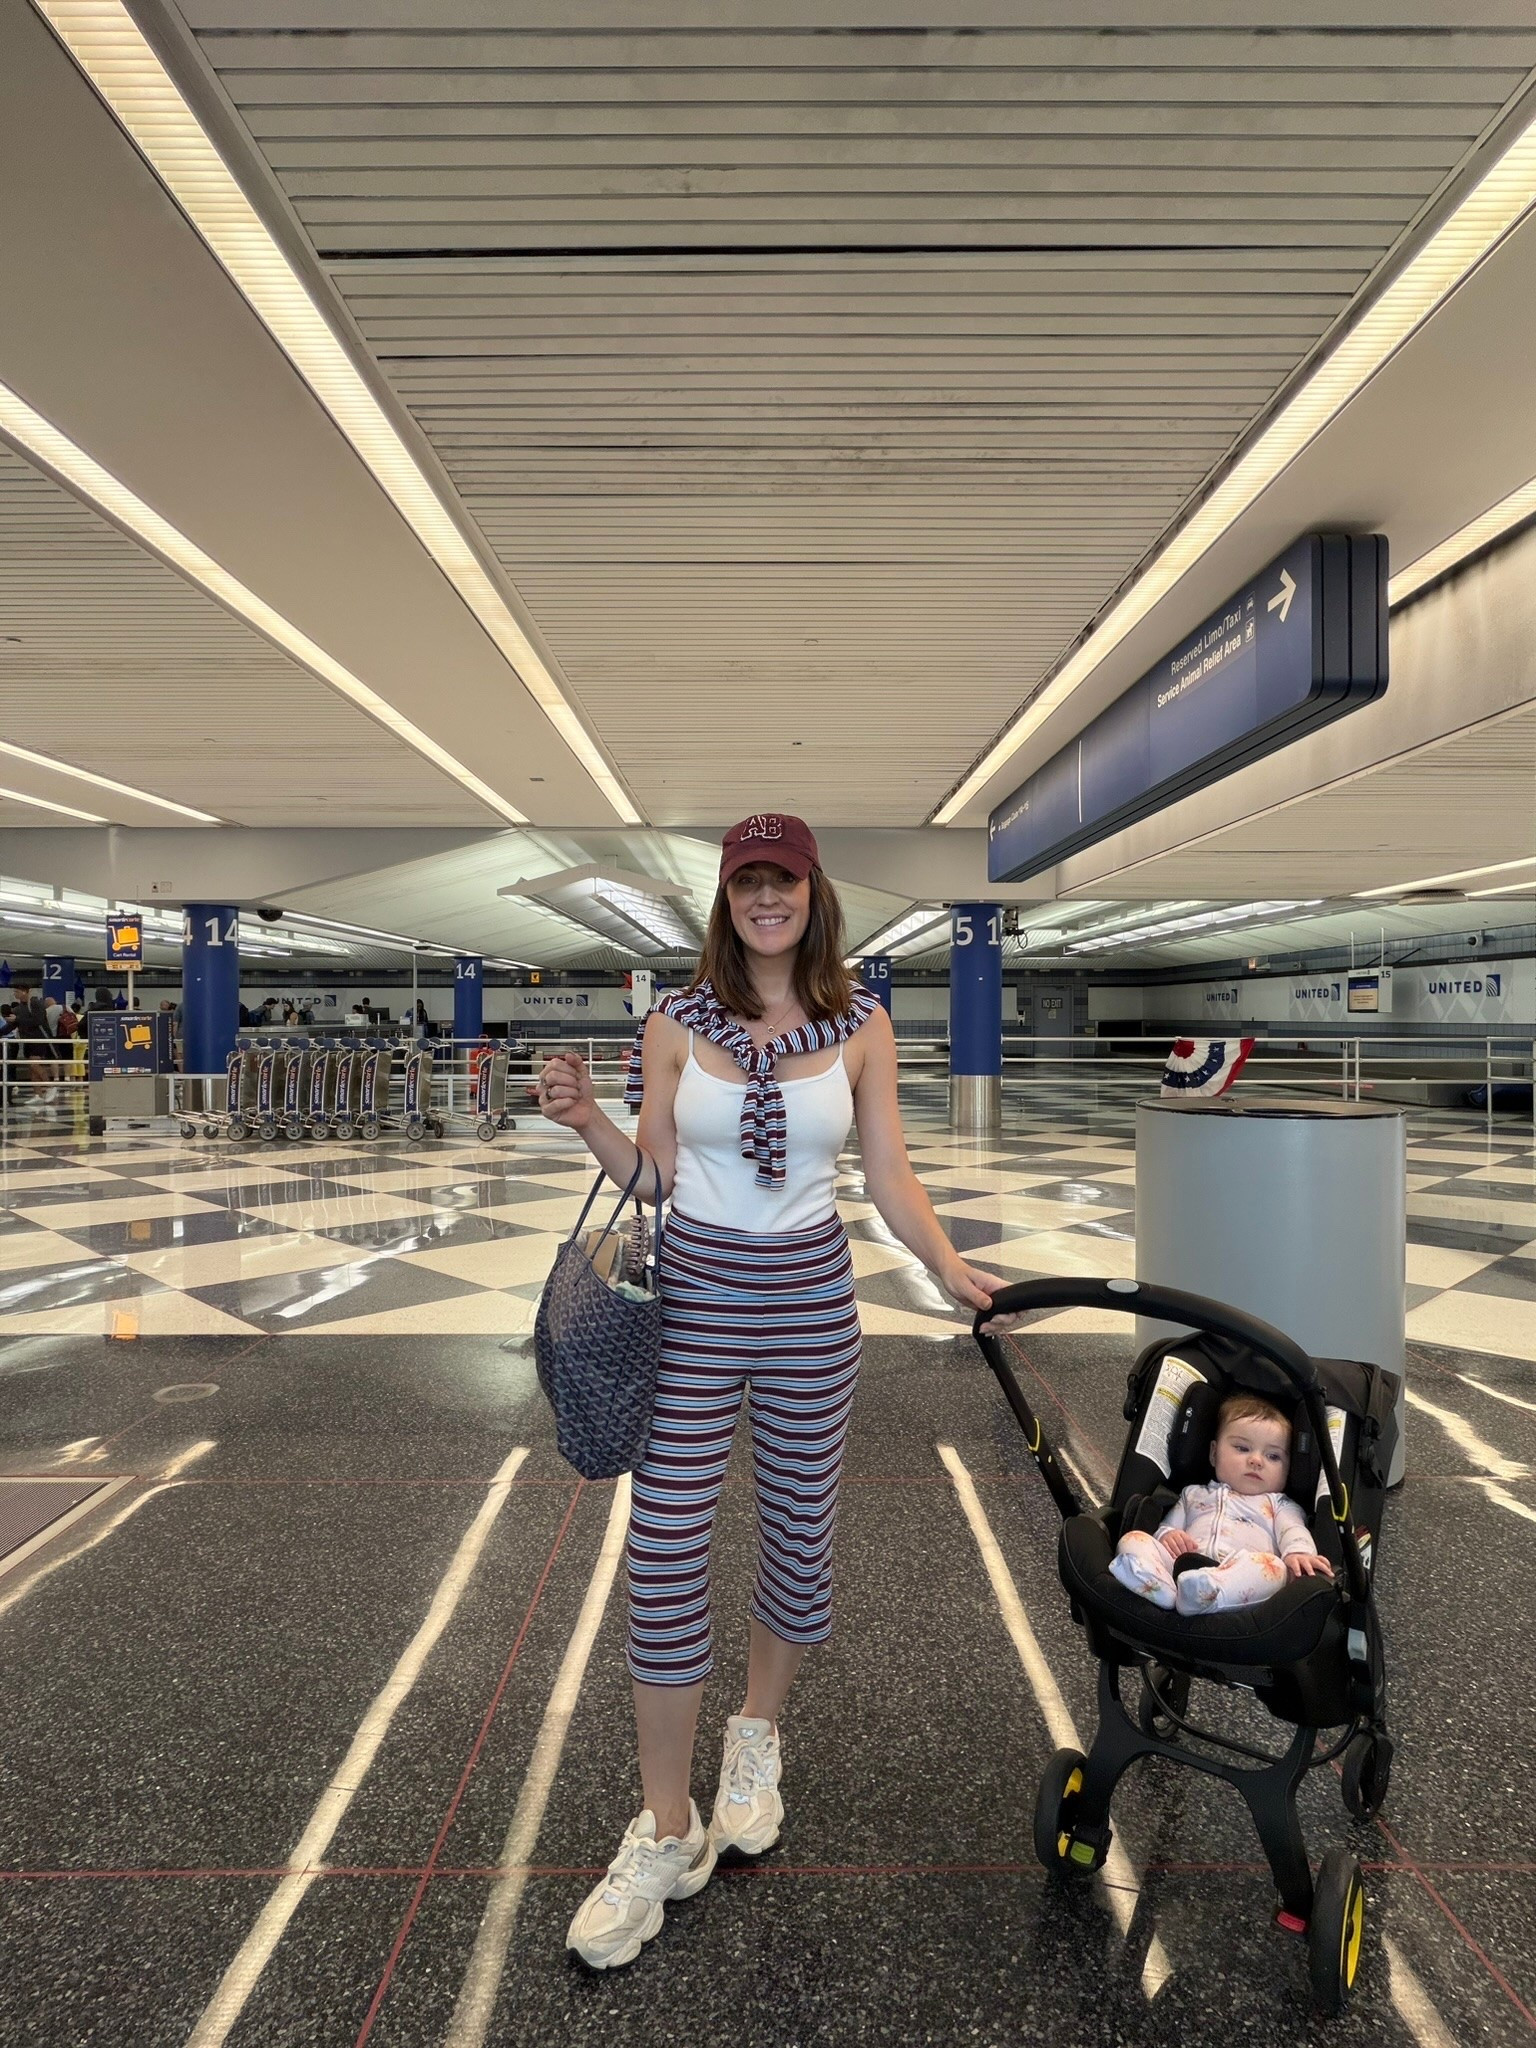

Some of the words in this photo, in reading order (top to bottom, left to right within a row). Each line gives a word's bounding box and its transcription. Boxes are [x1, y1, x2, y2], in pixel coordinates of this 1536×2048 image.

[1171, 639, 1203, 676] Reserved
[1204, 606, 1241, 648] Limo/Taxi
[1157, 682, 1180, 708] Service
[1180, 662, 1202, 691] Animal
[1203, 647, 1223, 674] Relief
[1224, 634, 1242, 658] Area
[205, 917, 238, 947] 14
[42, 963, 62, 980] 12
[455, 963, 476, 979] 14
[635, 974, 647, 982] 14
[868, 963, 888, 979] 15
[1380, 970, 1391, 978] 15
[1295, 988, 1329, 999] UNITED
[1428, 980, 1482, 994] UNITED
[1043, 1000, 1050, 1008] NO
[1051, 1000, 1061, 1008] EXIT
[1206, 993, 1230, 1002] UNITED
